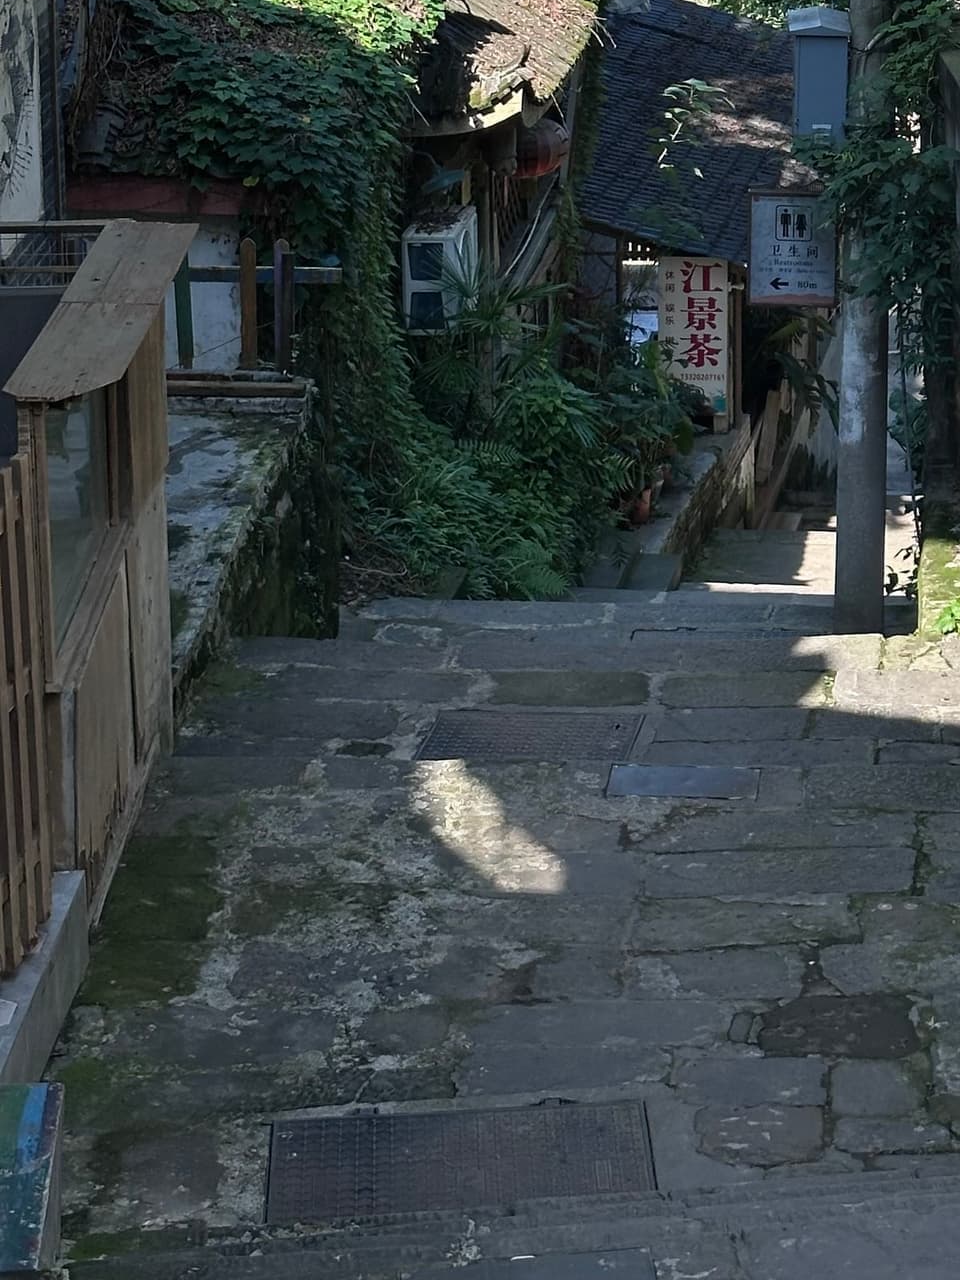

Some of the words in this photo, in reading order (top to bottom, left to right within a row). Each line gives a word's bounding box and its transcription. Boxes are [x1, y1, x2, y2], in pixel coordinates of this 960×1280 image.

[768, 244, 819, 259] 卫生间
[680, 261, 723, 368] 江景茶
